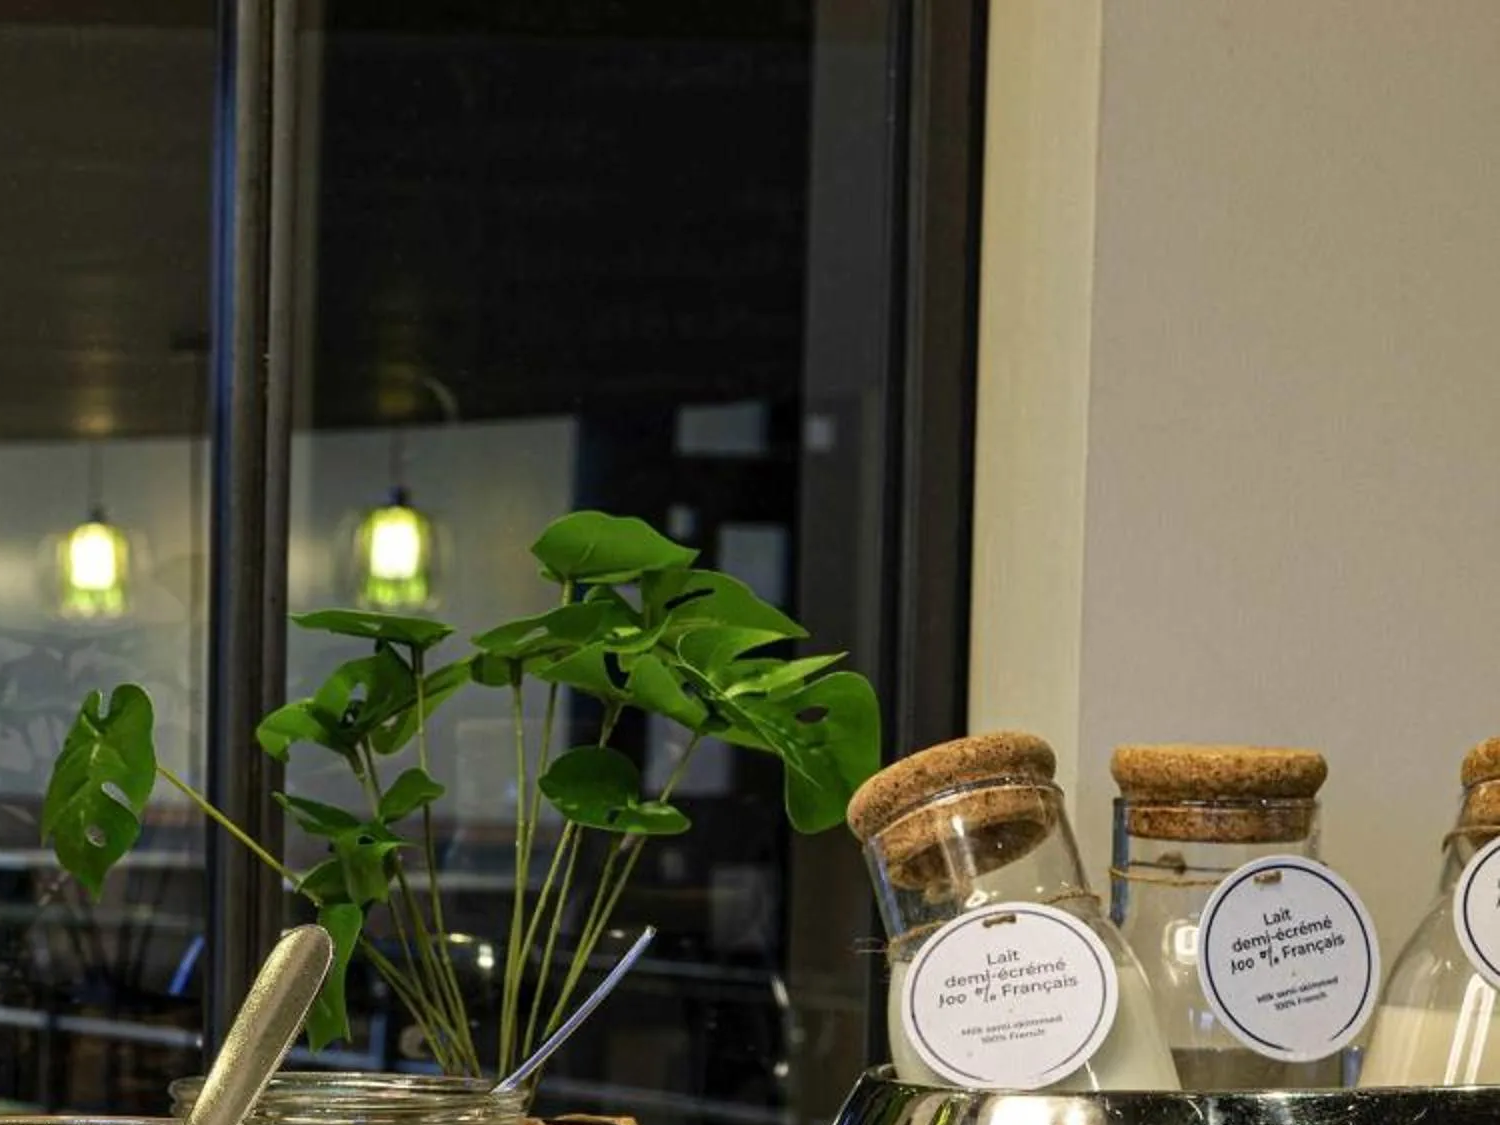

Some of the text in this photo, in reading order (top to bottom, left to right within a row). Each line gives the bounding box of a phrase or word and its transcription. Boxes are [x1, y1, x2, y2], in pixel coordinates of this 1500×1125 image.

[1263, 908, 1292, 926] Lait
[1232, 915, 1332, 952] demi-écrémé
[1282, 932, 1345, 959] Français
[986, 950, 1020, 966] Lait
[944, 957, 1066, 988] demi-écrémé
[1001, 975, 1077, 997] Français
